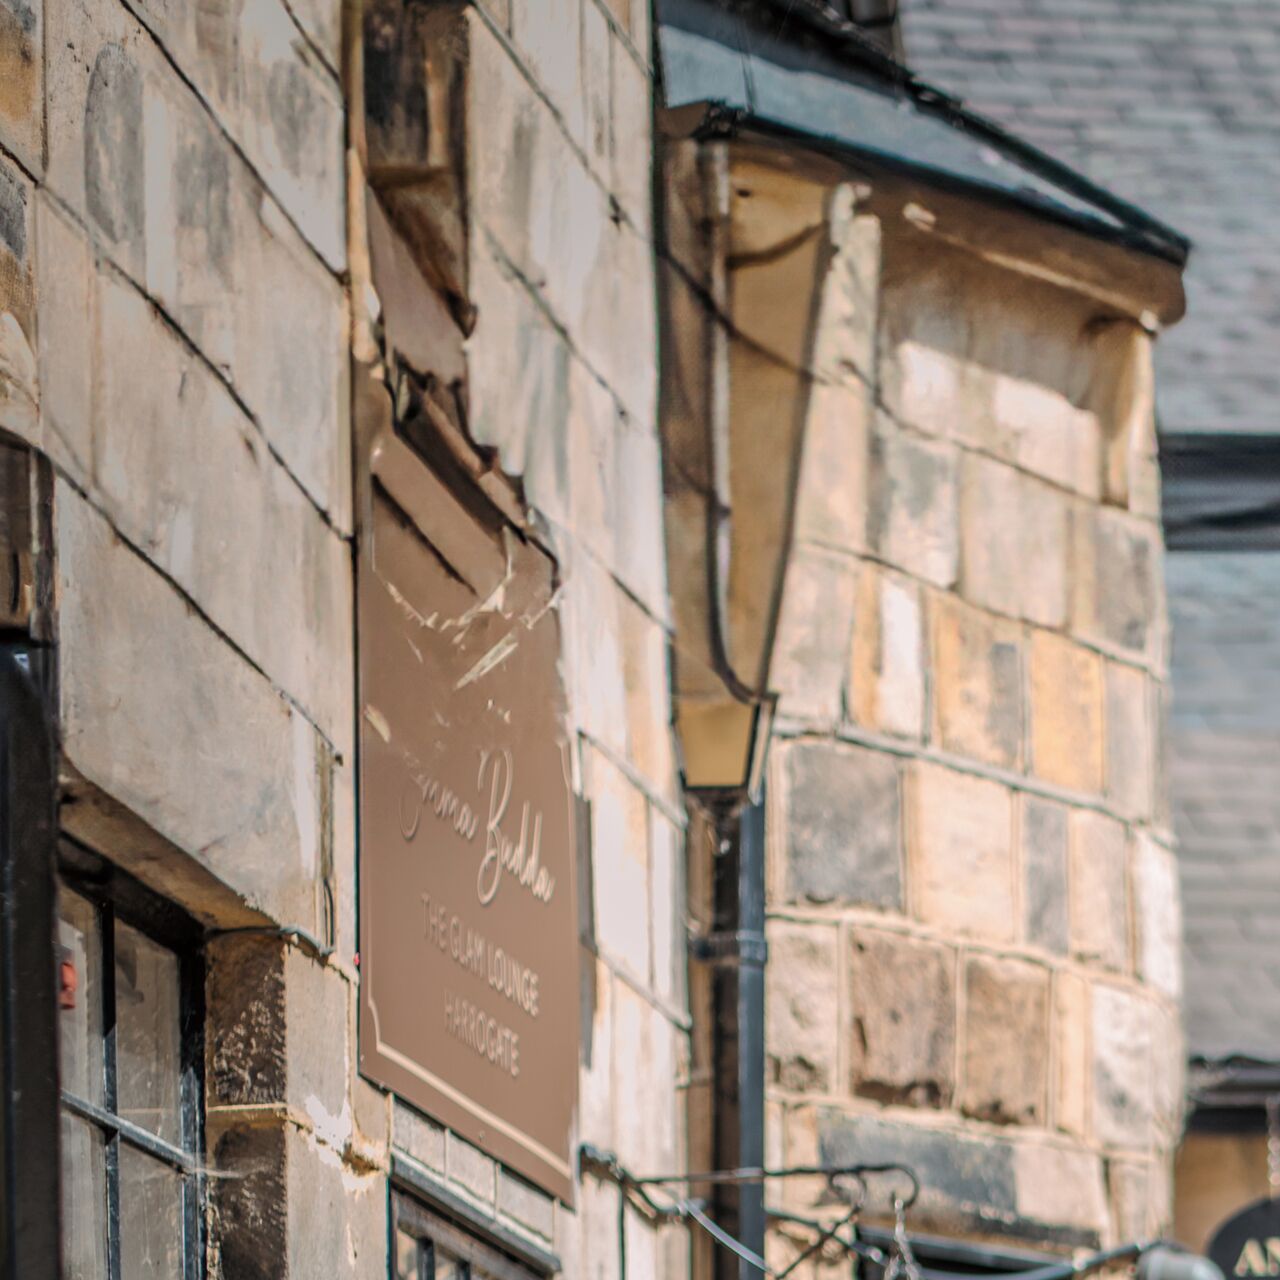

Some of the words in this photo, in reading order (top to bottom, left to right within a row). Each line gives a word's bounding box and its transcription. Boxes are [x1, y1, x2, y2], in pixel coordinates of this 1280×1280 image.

[421, 893, 447, 950] THE
[450, 916, 485, 978] GLAM
[487, 941, 540, 1017] LOUNGE
[444, 988, 519, 1077] HARROGATE
